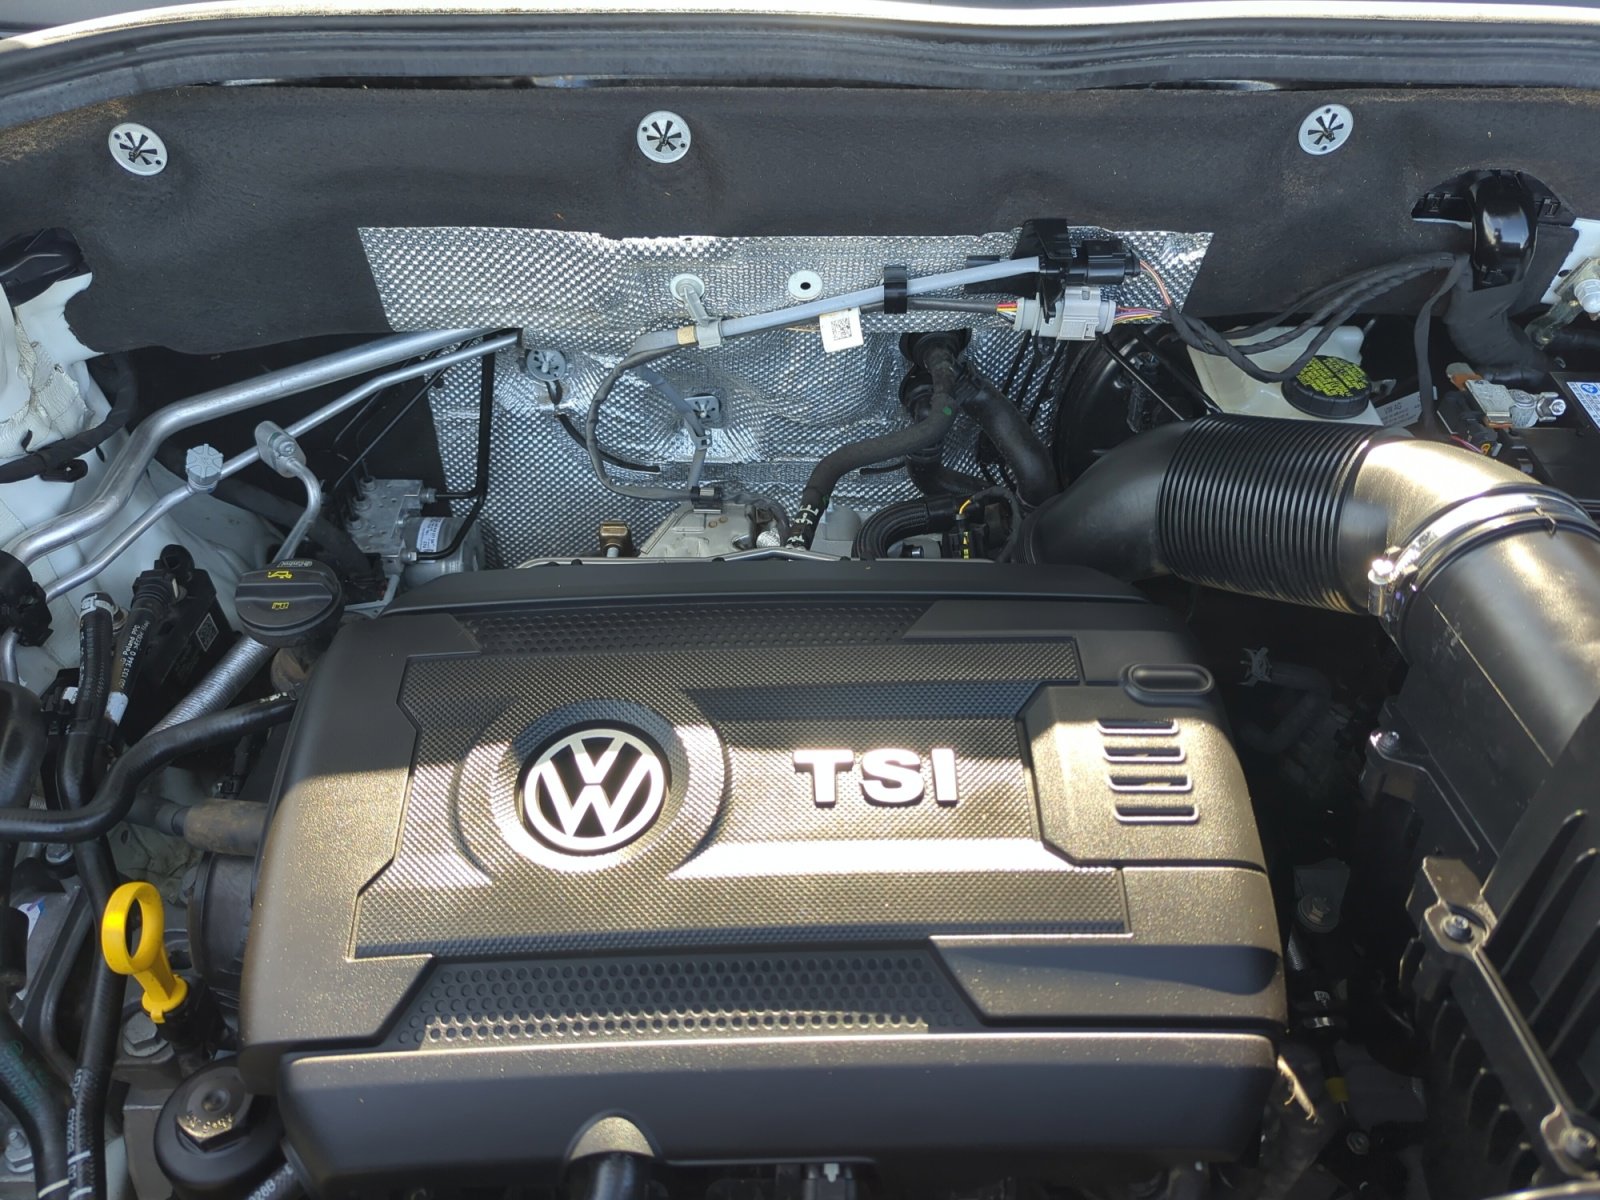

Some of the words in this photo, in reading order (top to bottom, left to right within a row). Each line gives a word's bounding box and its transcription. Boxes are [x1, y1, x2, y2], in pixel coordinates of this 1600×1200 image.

[123, 635, 135, 655] Poland
[524, 728, 666, 851] VW
[793, 748, 958, 807] TSI
